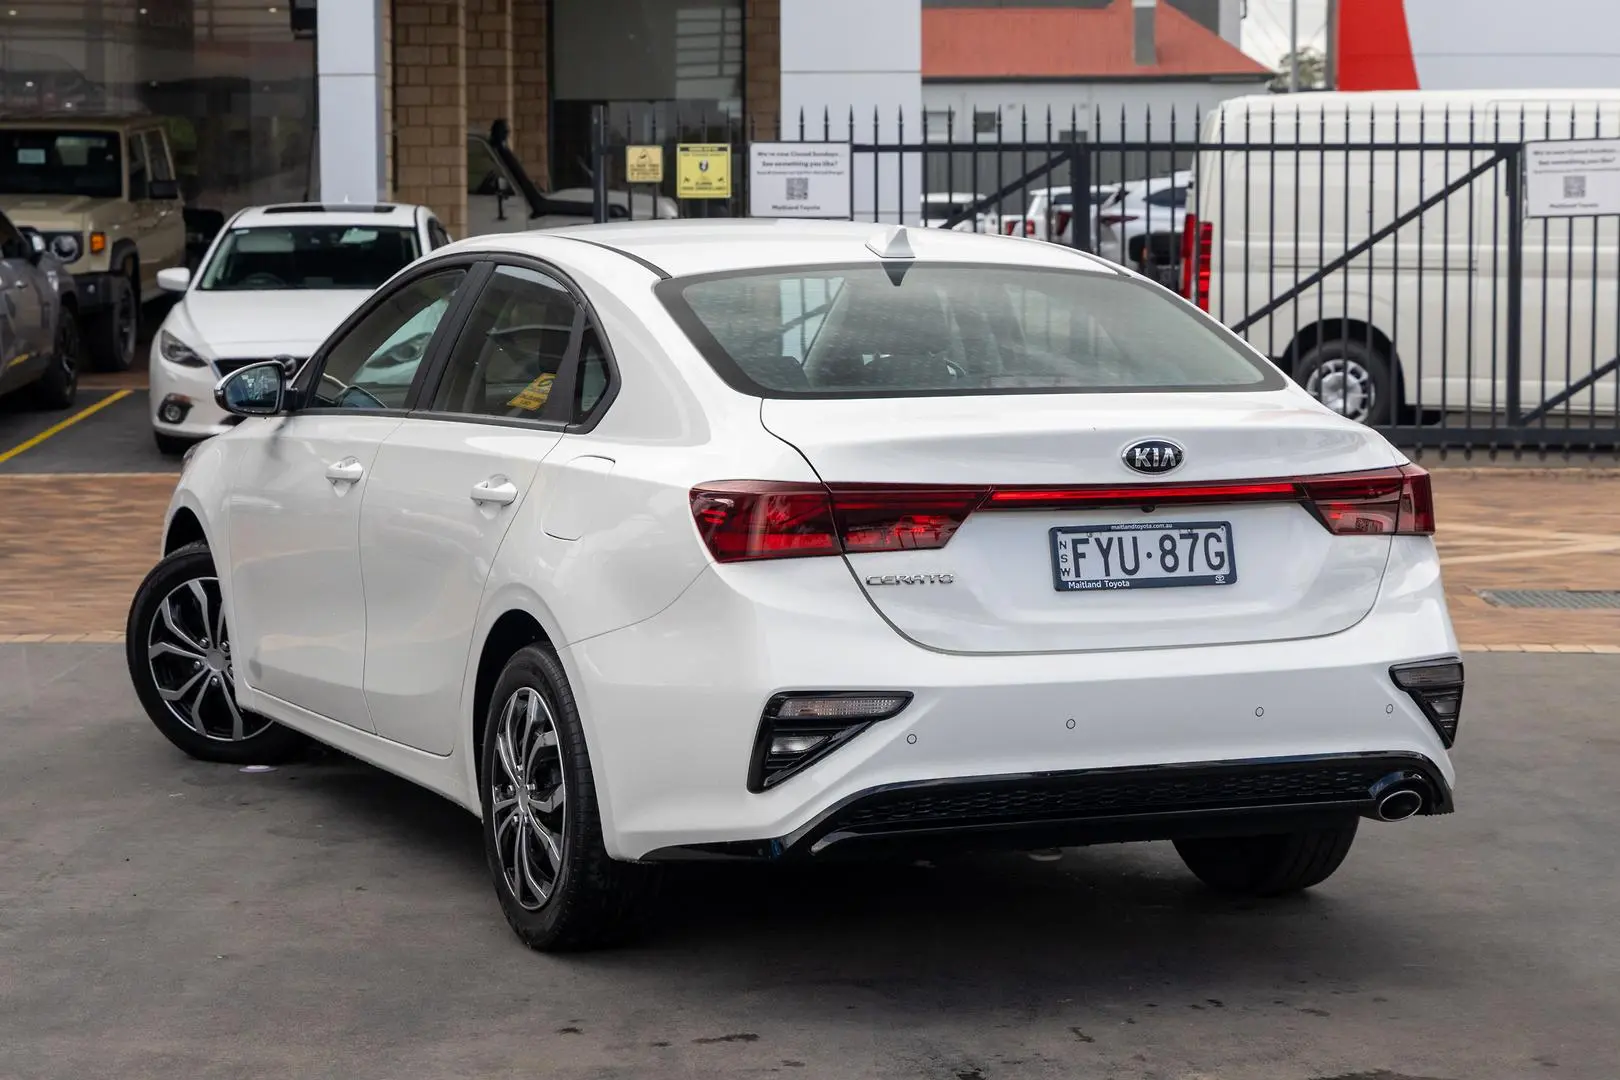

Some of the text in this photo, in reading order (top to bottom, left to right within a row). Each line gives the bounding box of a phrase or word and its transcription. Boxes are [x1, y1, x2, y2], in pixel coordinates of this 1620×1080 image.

[1134, 447, 1177, 467] KIA
[866, 574, 954, 586] CERATO
[1068, 580, 1130, 589] Maitland Toyota
